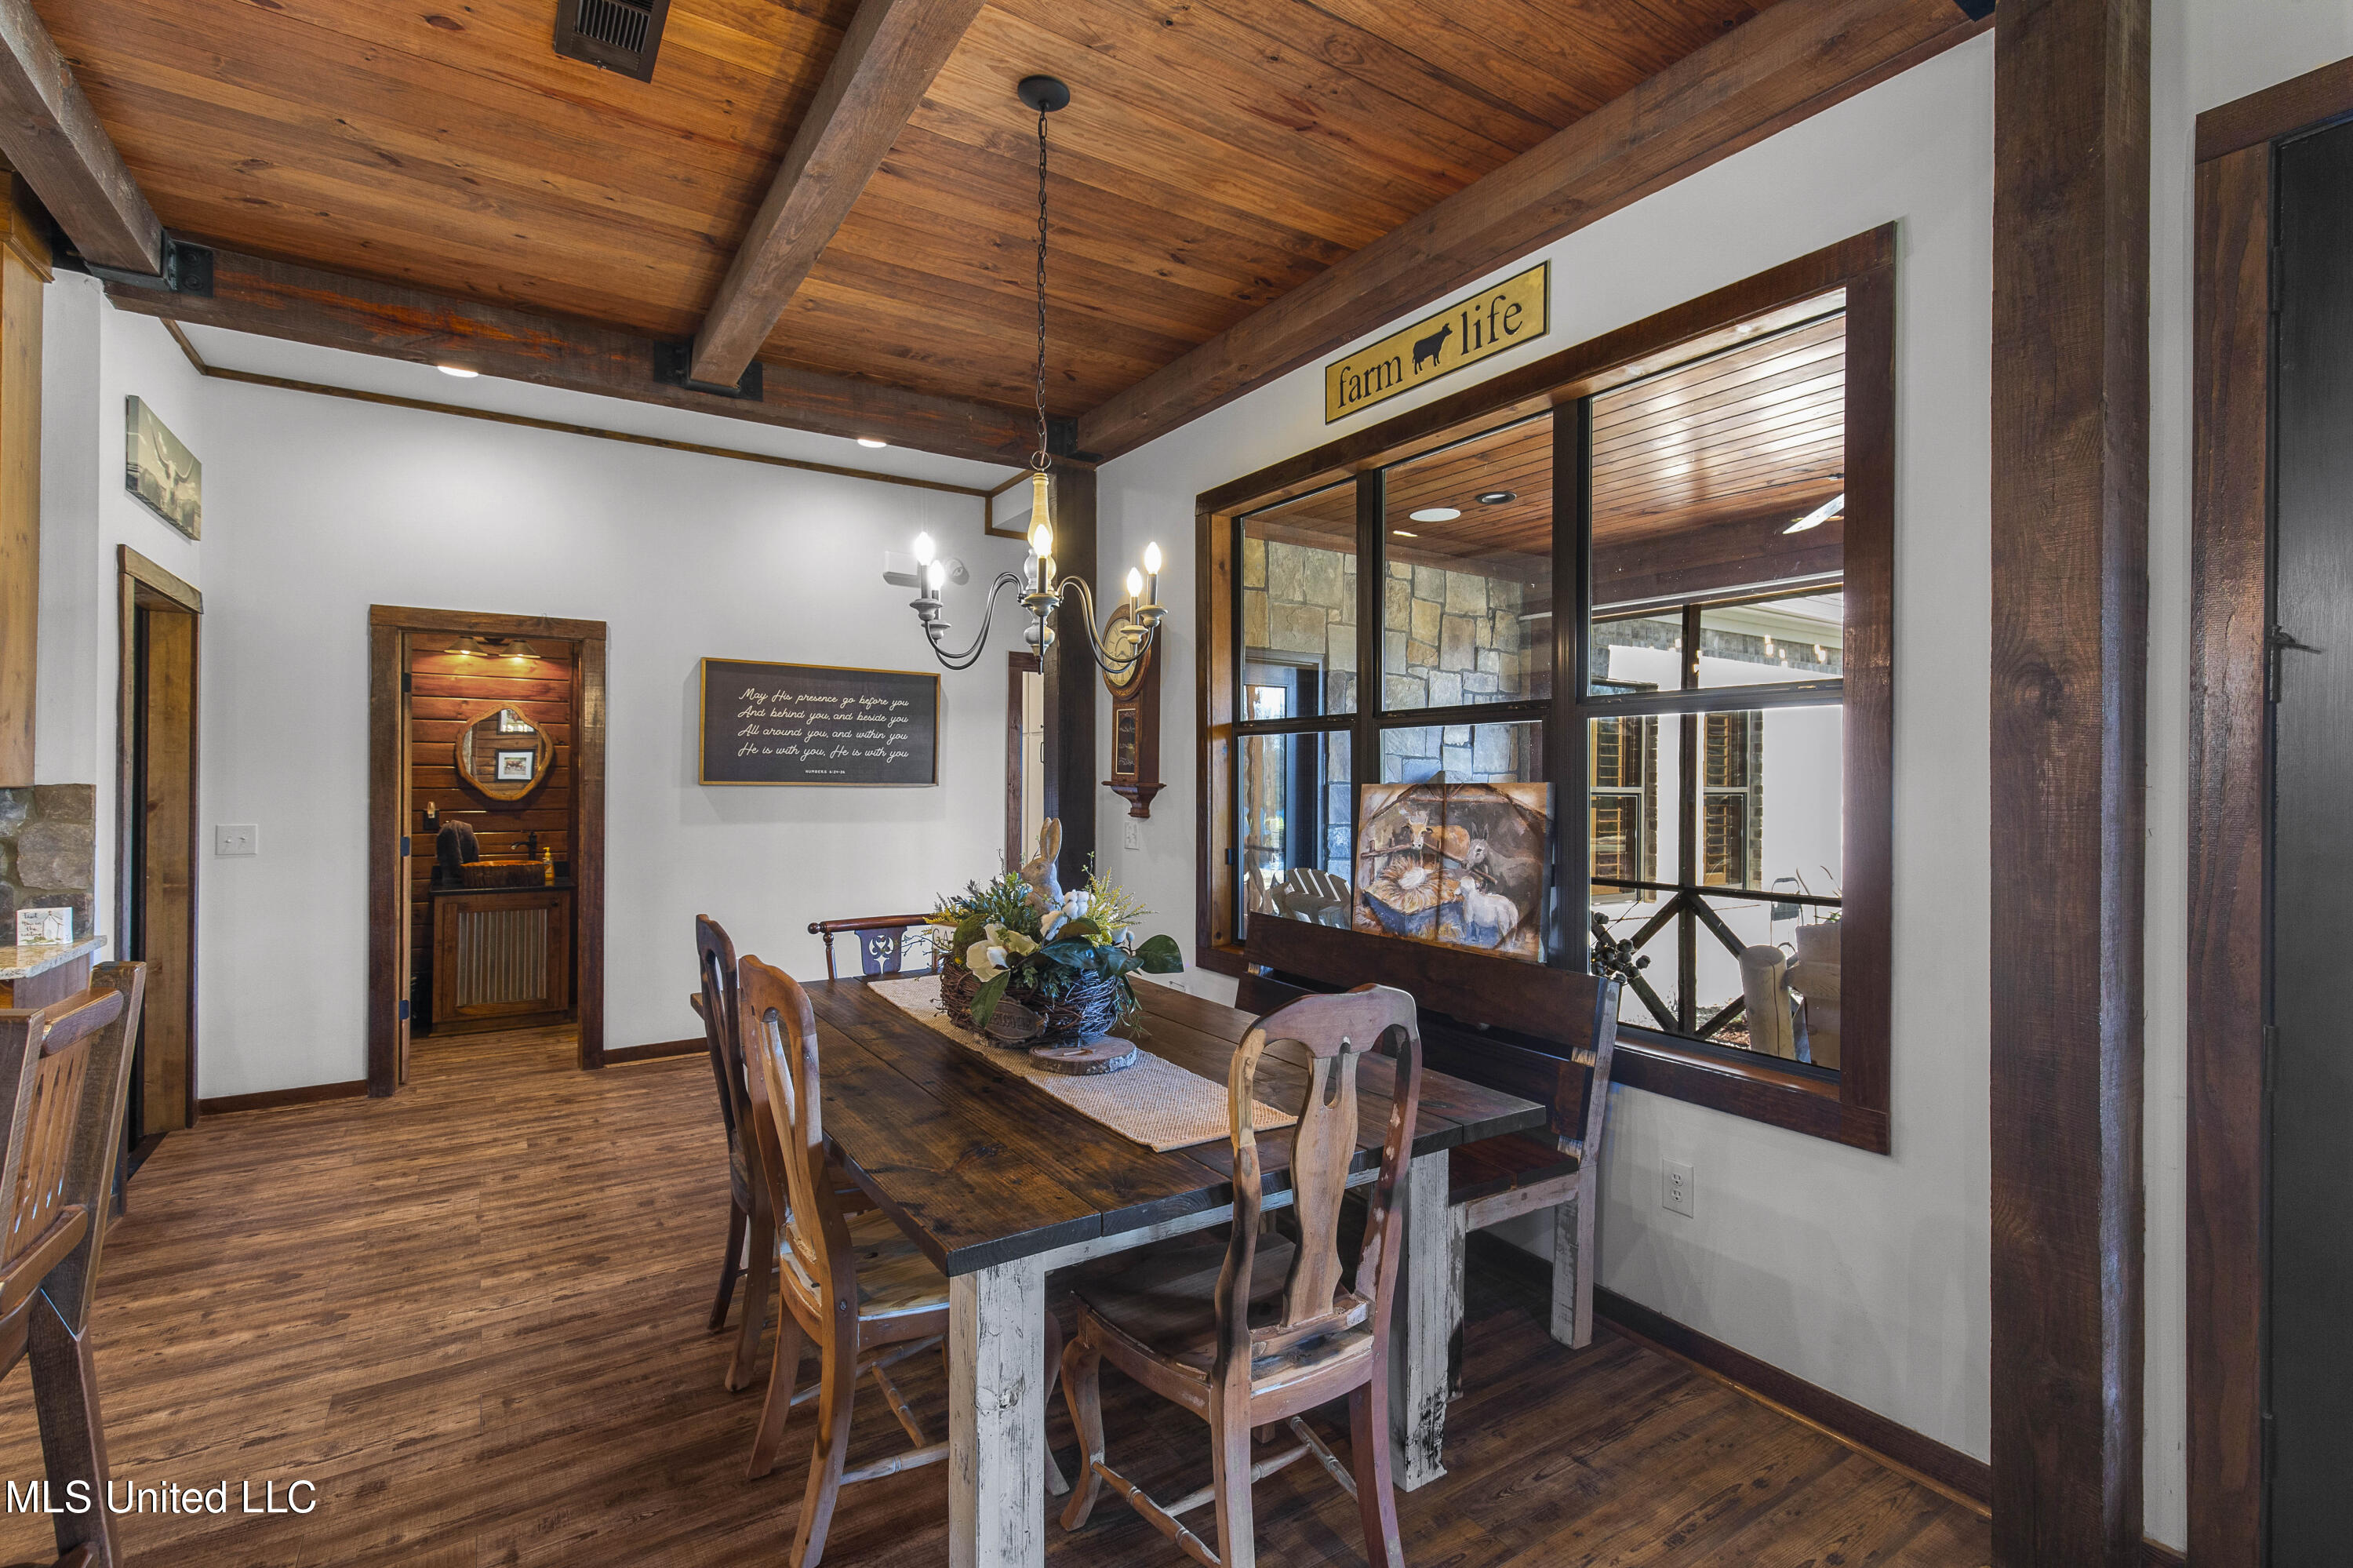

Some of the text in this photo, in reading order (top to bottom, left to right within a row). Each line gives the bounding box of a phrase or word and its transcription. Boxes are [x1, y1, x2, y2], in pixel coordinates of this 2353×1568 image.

[1337, 294, 1523, 409] farm life
[738, 687, 910, 711] May His presence go before you
[737, 704, 909, 729] And behind you, and beside you
[737, 723, 908, 746] All around you, and within you
[737, 741, 759, 757] He
[762, 746, 773, 755] is
[776, 744, 800, 755] with
[829, 744, 849, 759] He
[864, 746, 887, 757] with
[886, 751, 910, 764] you
